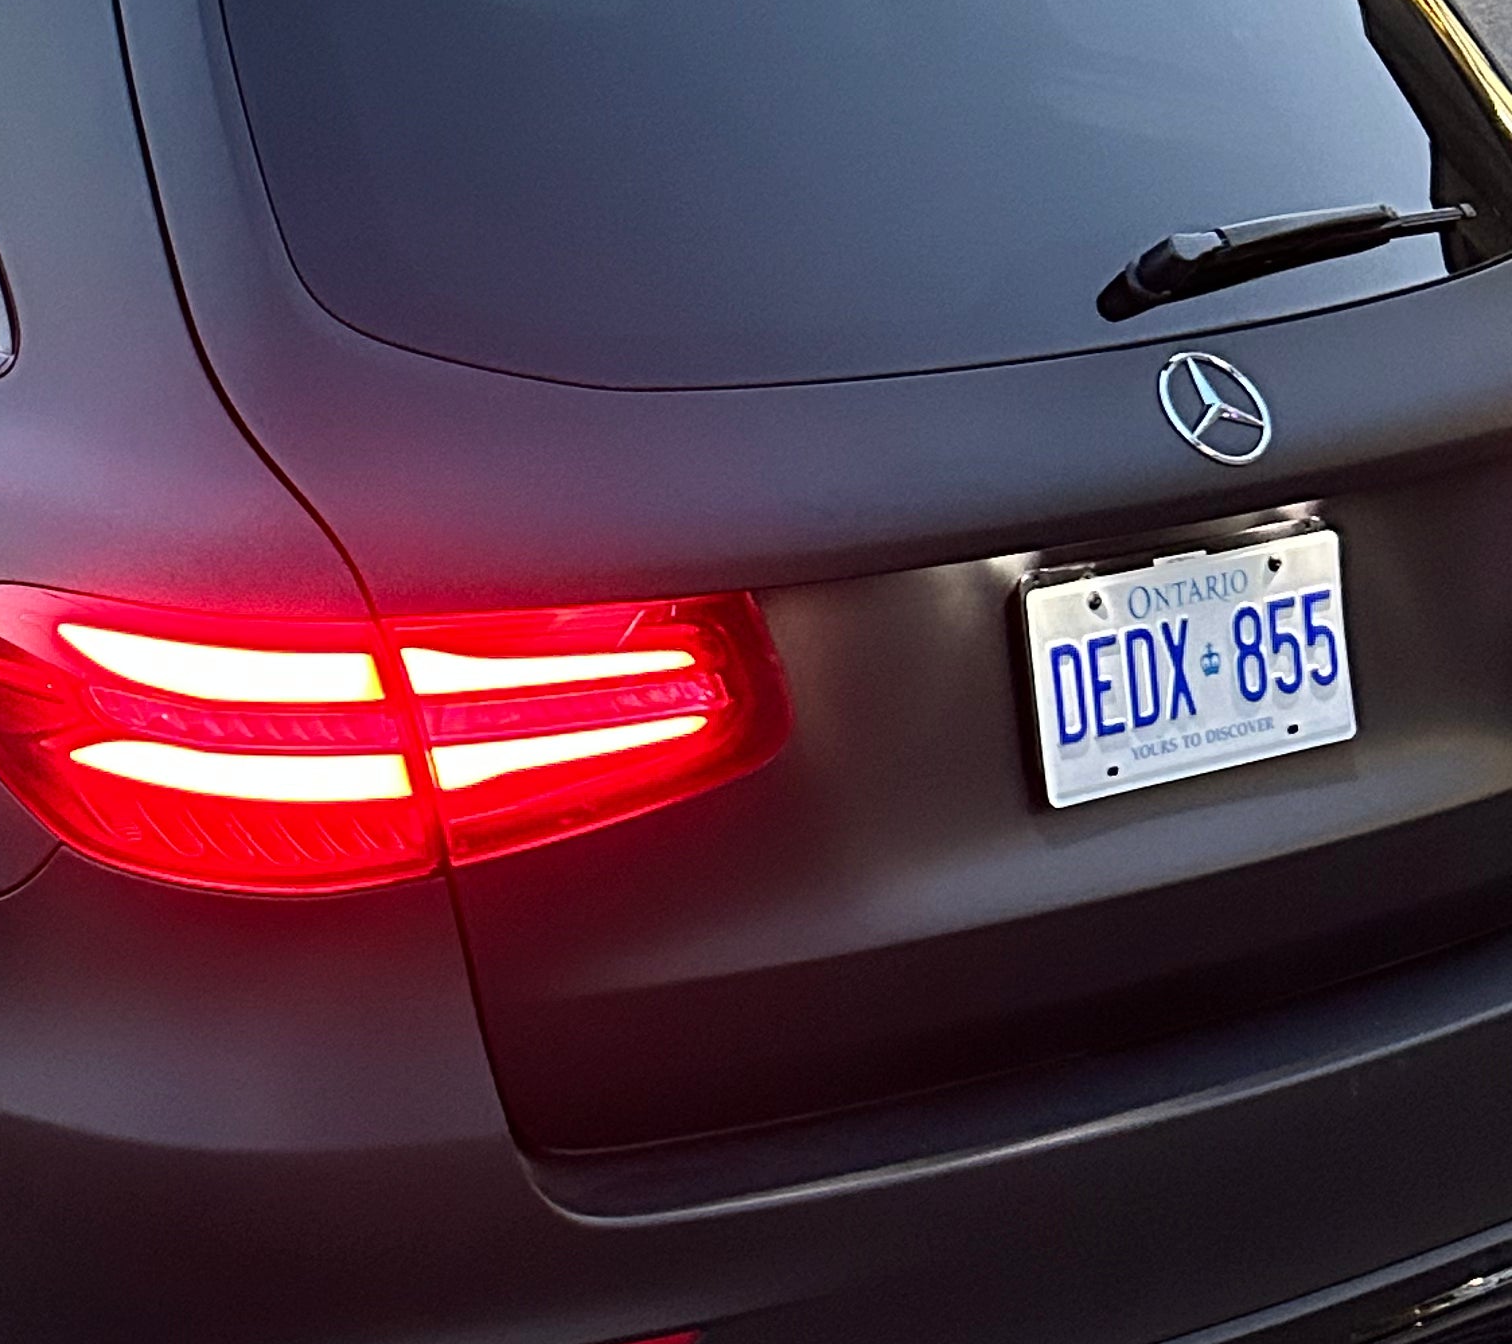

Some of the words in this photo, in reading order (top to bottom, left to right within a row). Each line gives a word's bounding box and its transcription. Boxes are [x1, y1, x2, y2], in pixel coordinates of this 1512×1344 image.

[1127, 568, 1248, 619] ONTARIO
[1049, 617, 1197, 745] DEDX
[1232, 588, 1339, 703] 855
[1130, 733, 1179, 761] YOURS
[1182, 728, 1202, 749] TO
[1205, 716, 1275, 744] DISCOVER
